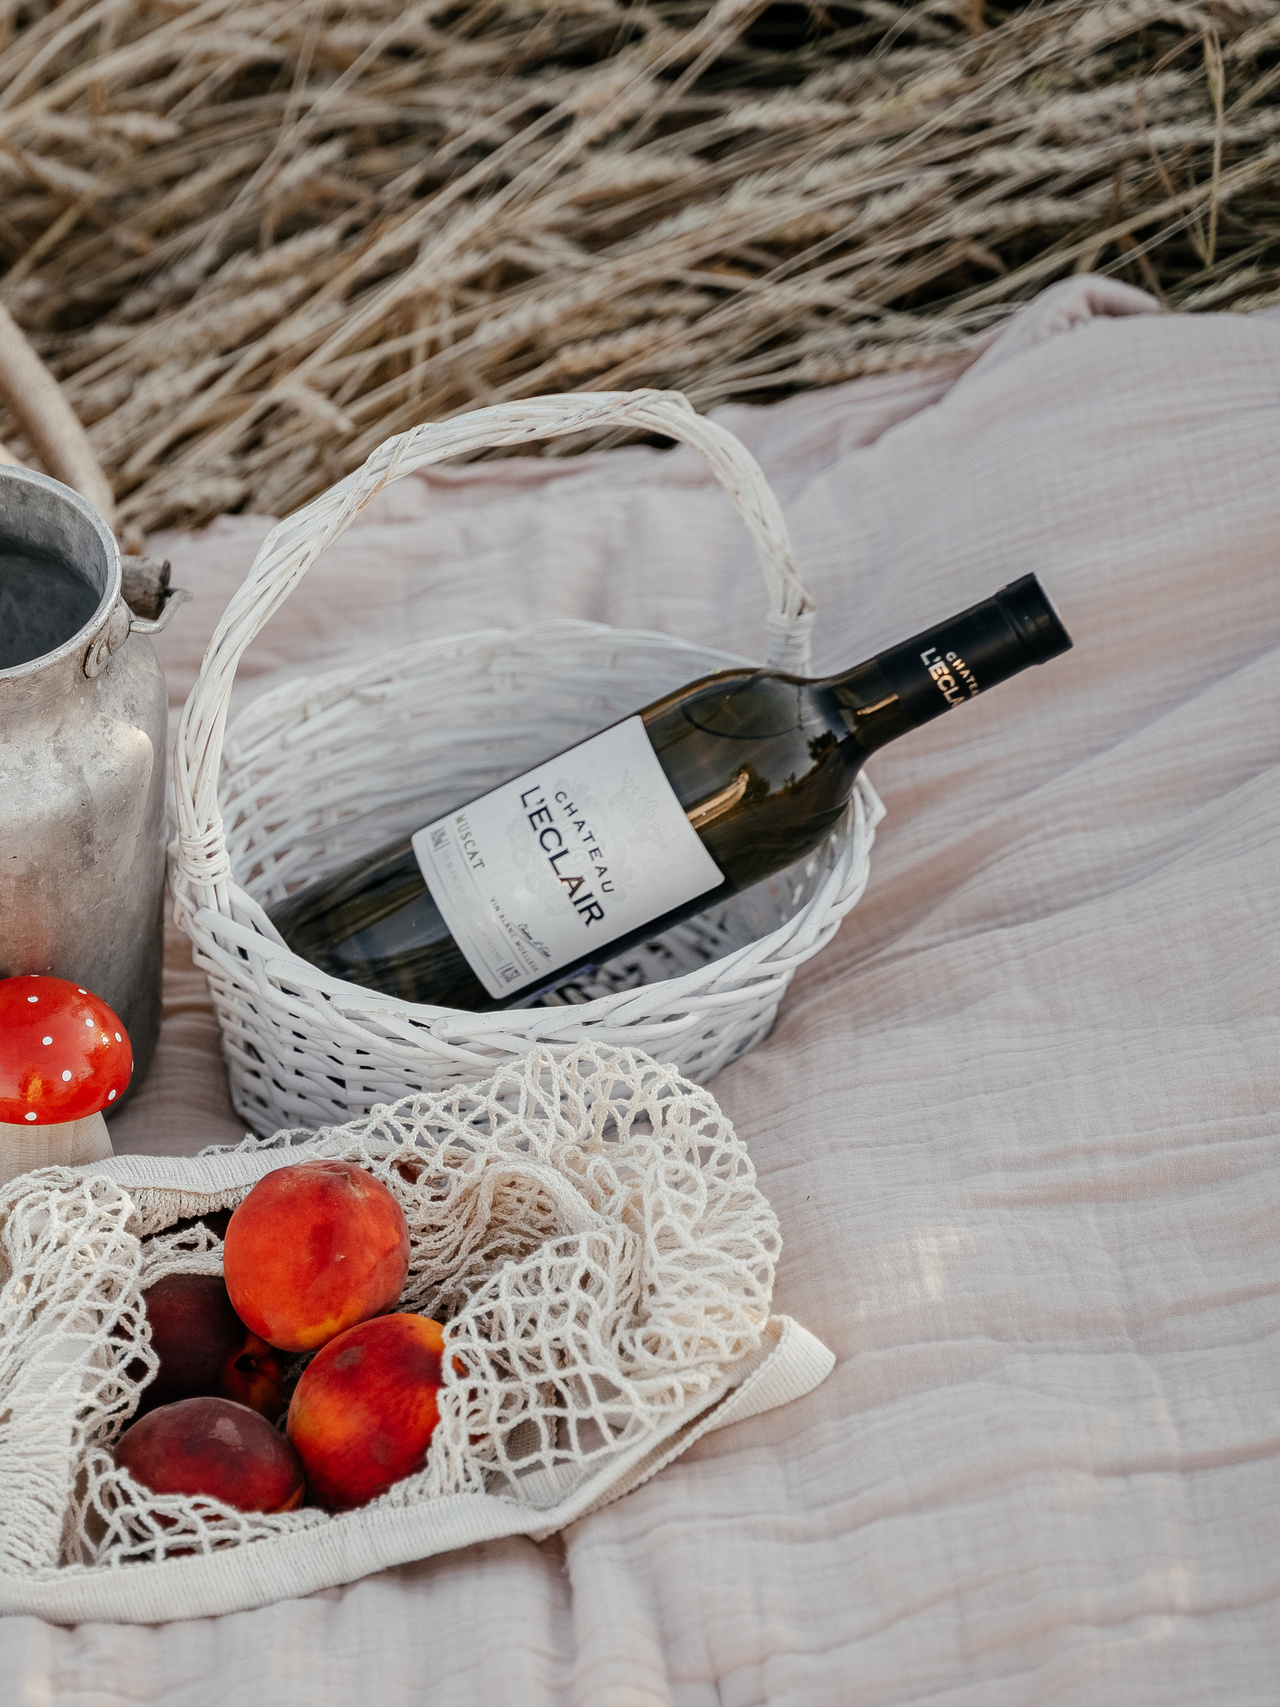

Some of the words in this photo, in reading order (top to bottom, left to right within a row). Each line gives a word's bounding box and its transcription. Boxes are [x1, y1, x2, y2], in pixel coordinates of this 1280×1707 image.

[456, 813, 486, 869] MUSCAT
[520, 785, 606, 928] L'ECLAIR
[554, 791, 615, 894] CHATEAU
